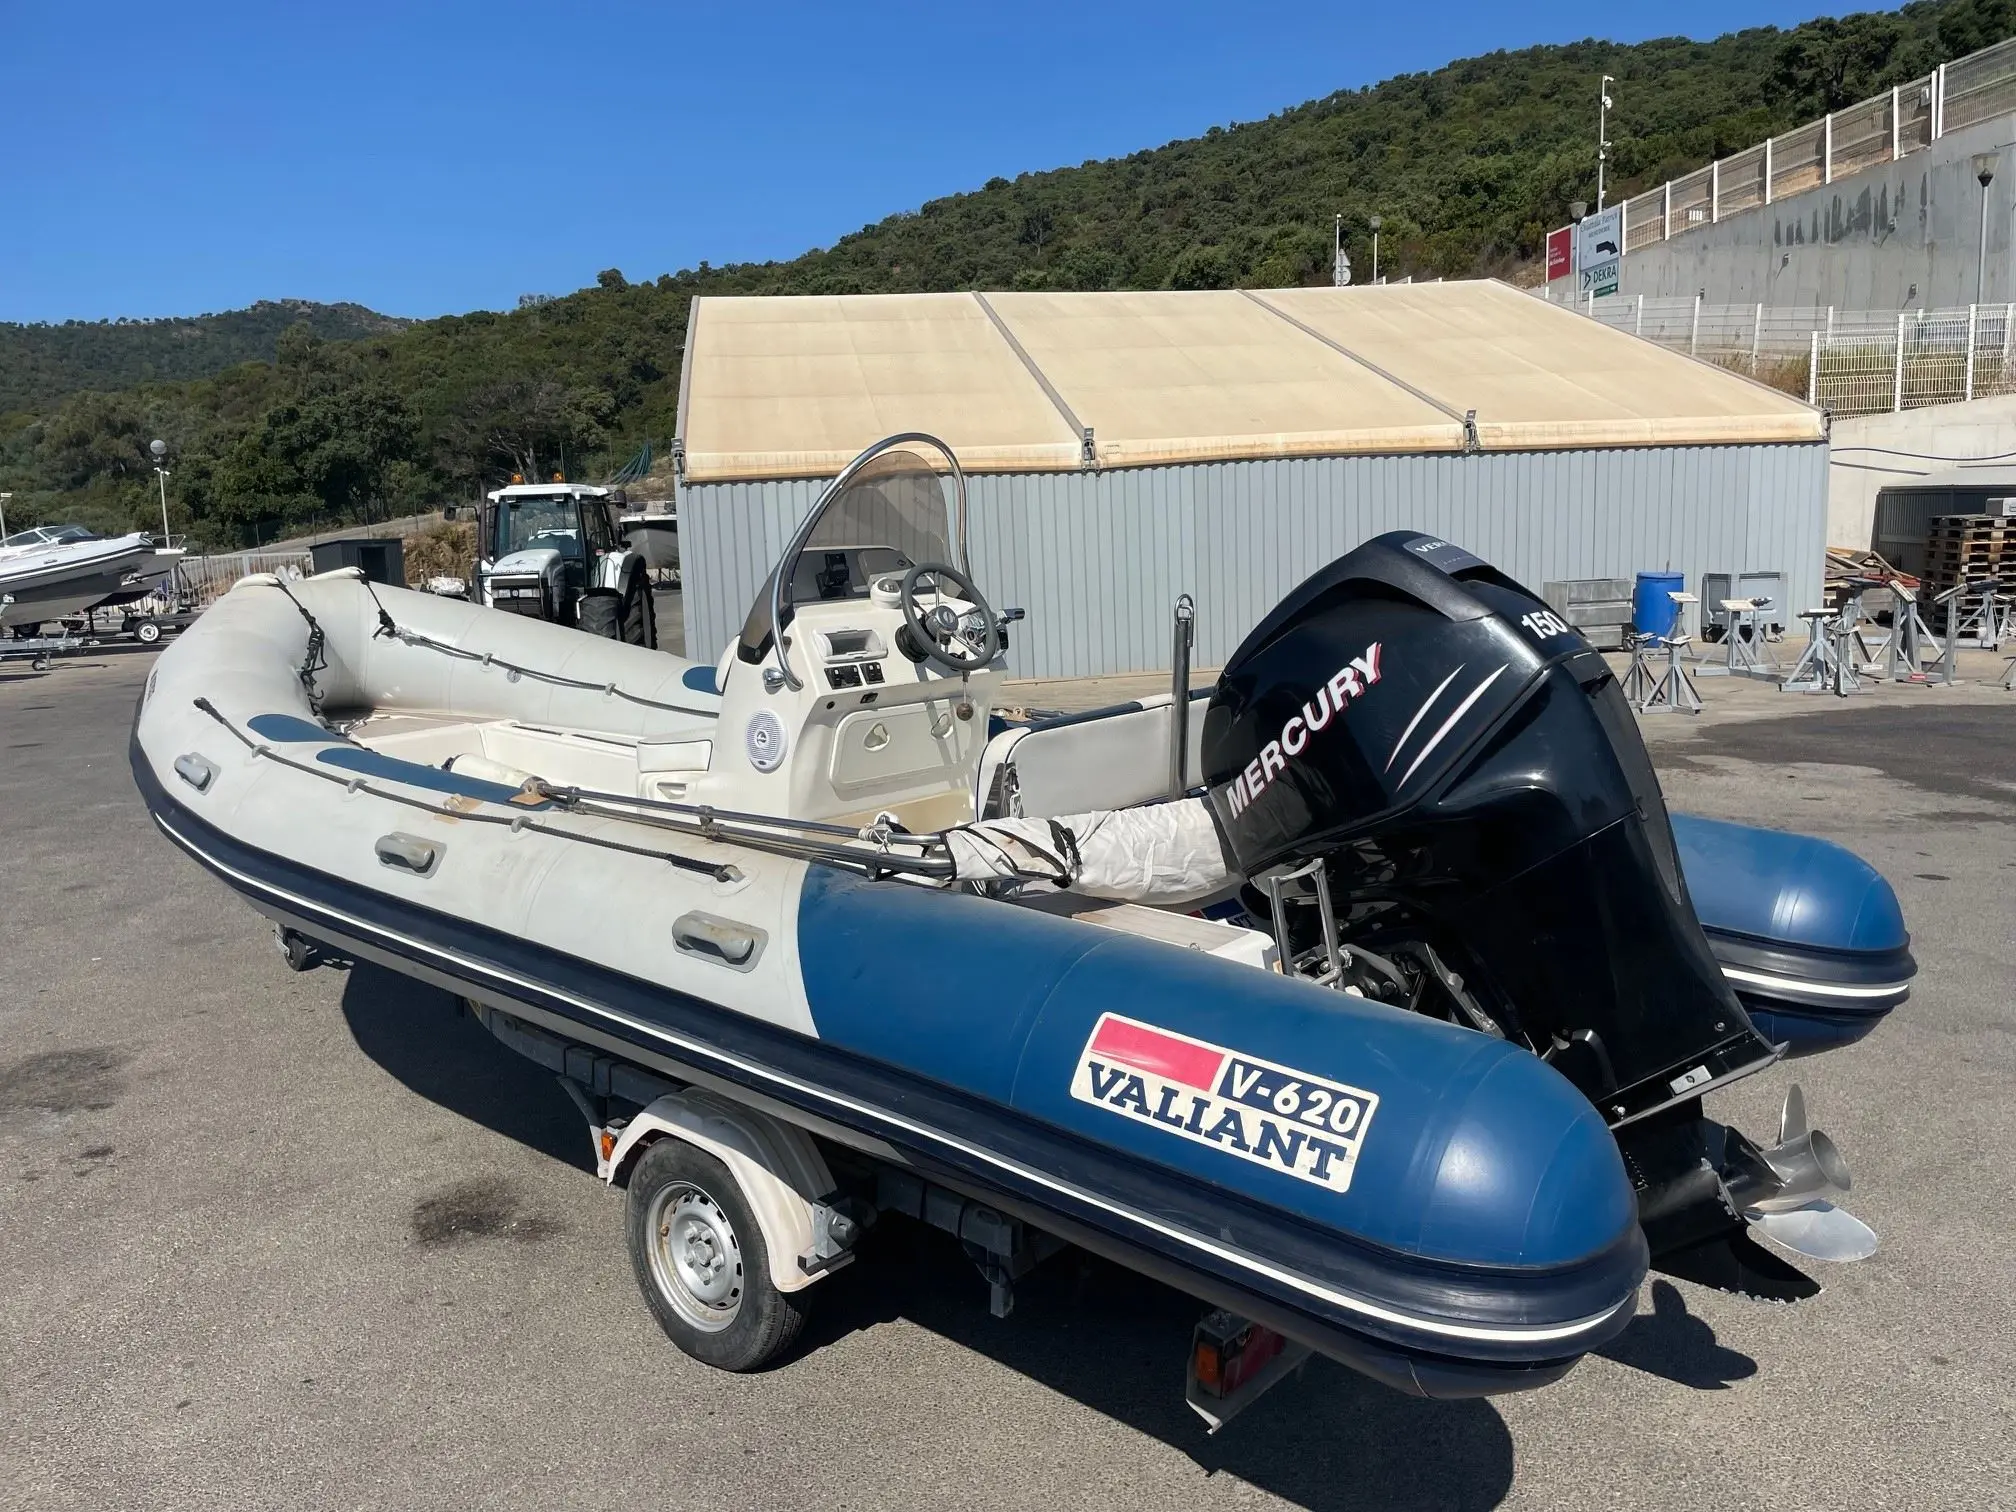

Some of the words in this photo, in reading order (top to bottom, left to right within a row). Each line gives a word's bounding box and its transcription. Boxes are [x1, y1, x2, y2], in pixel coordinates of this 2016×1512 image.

[1593, 265, 1617, 283] DEKRA
[1521, 610, 1568, 639] 150
[1225, 641, 1382, 820] MERCURY
[1088, 1060, 1348, 1181] VALIANT
[1231, 1063, 1360, 1134] V-620
